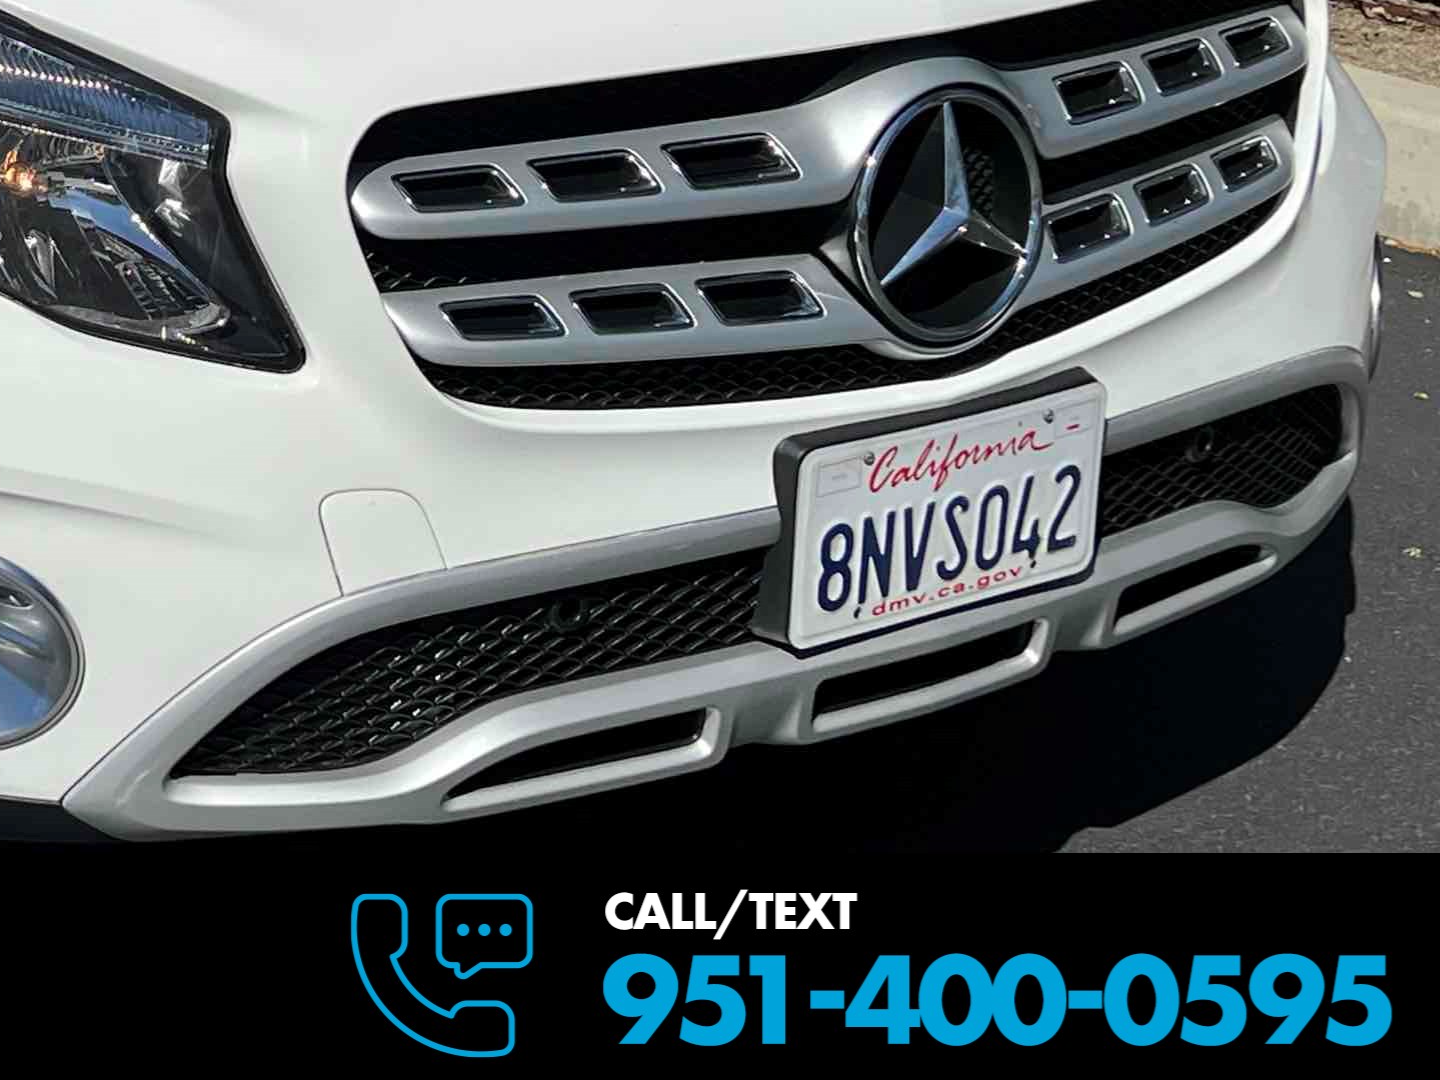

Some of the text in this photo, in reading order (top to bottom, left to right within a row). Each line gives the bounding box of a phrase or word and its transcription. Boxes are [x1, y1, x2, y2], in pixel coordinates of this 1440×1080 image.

[868, 429, 1053, 494] California
[817, 464, 1082, 612] 8NVS042
[871, 565, 1023, 617] dmv.ca.gov
